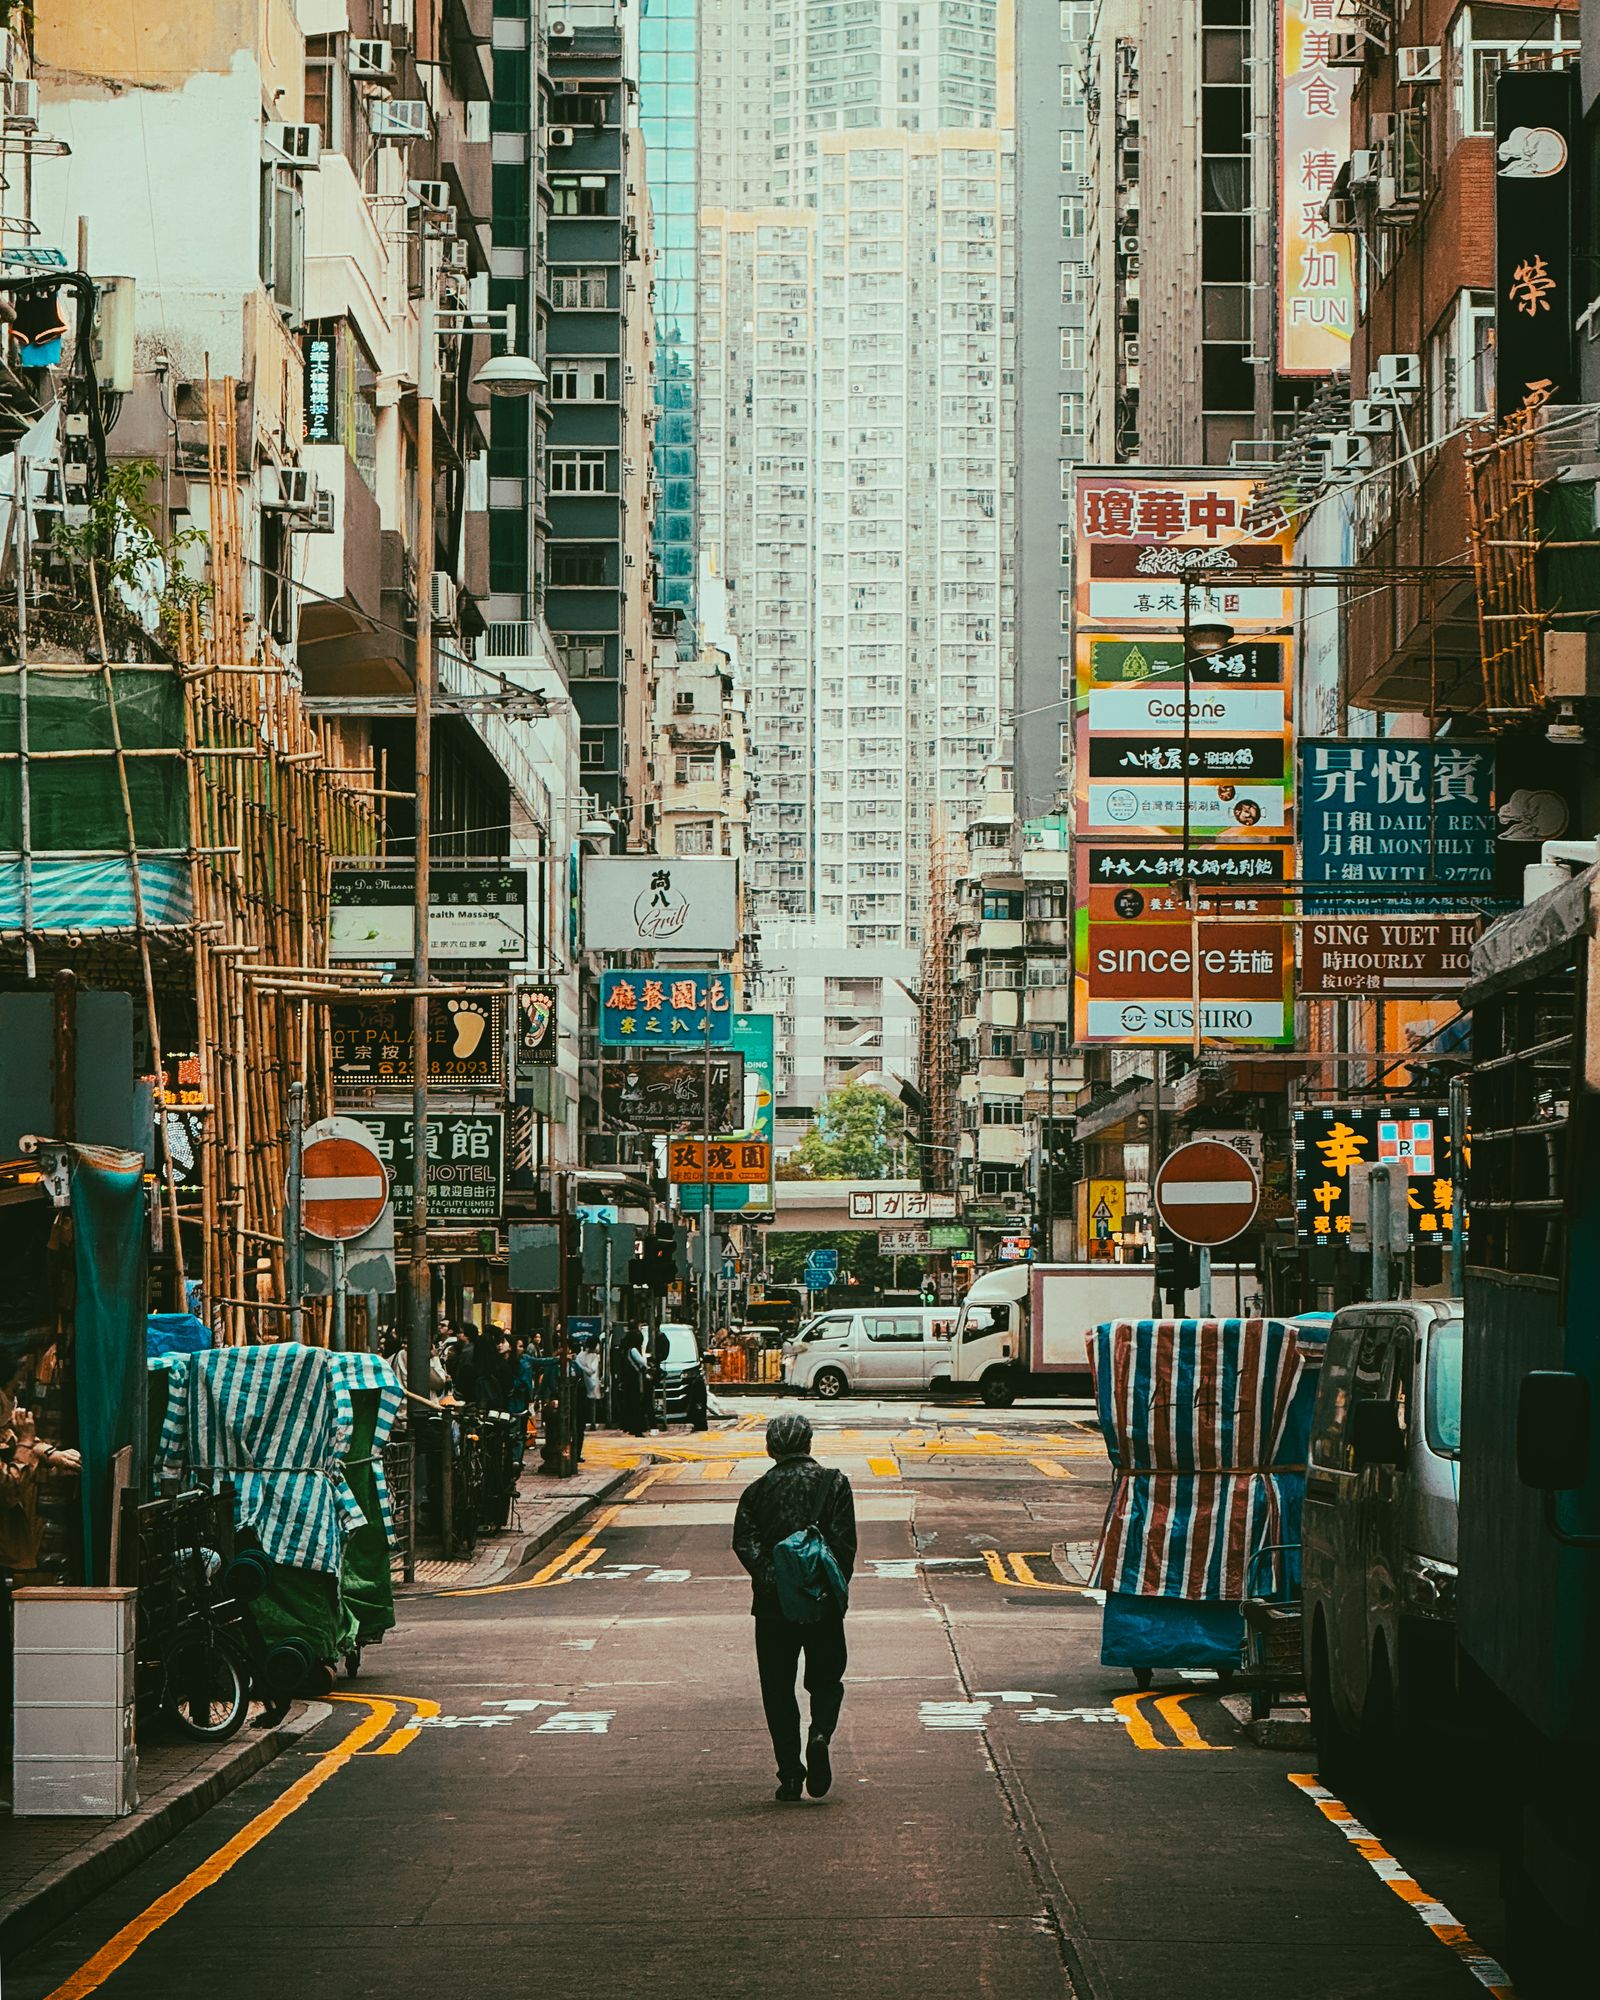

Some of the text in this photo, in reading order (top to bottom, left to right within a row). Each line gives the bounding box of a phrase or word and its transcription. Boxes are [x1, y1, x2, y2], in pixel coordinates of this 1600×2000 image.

[1302, 151, 1336, 288] 精彩加
[1293, 300, 1346, 322] FUN
[1084, 487, 1290, 539] 瓊華中心
[1147, 698, 1226, 717] Goobne
[1312, 747, 1496, 805] 昇悦賓
[1322, 811, 1374, 832] 日租
[1379, 815, 1438, 831] DAILY
[1320, 834, 1374, 856] 月租
[1378, 838, 1475, 854] MONTHLY
[1099, 856, 1274, 878] 牛大人台灣火鍋吃到飽
[1324, 862, 1363, 881] 上網
[354, 878, 373, 890] Da
[375, 878, 416, 890] Massa
[650, 869, 671, 908] 尚八
[430, 910, 500, 919] ealth Massage
[638, 903, 690, 938] Grill
[501, 939, 519, 949] 1/F
[1314, 924, 1369, 946] SING
[1379, 925, 1440, 946] YUET
[1229, 949, 1274, 974] 先施
[1321, 974, 1380, 990] 按10字樓
[1153, 1008, 1253, 1028] SUSHIRO
[330, 1045, 418, 1060] 正宗按
[398, 1061, 489, 1074] 238 2093
[1316, 1122, 1369, 1177] 幸
[427, 1164, 496, 1182] HOTEL
[393, 1184, 497, 1198] 豪華房歡迎自由行
